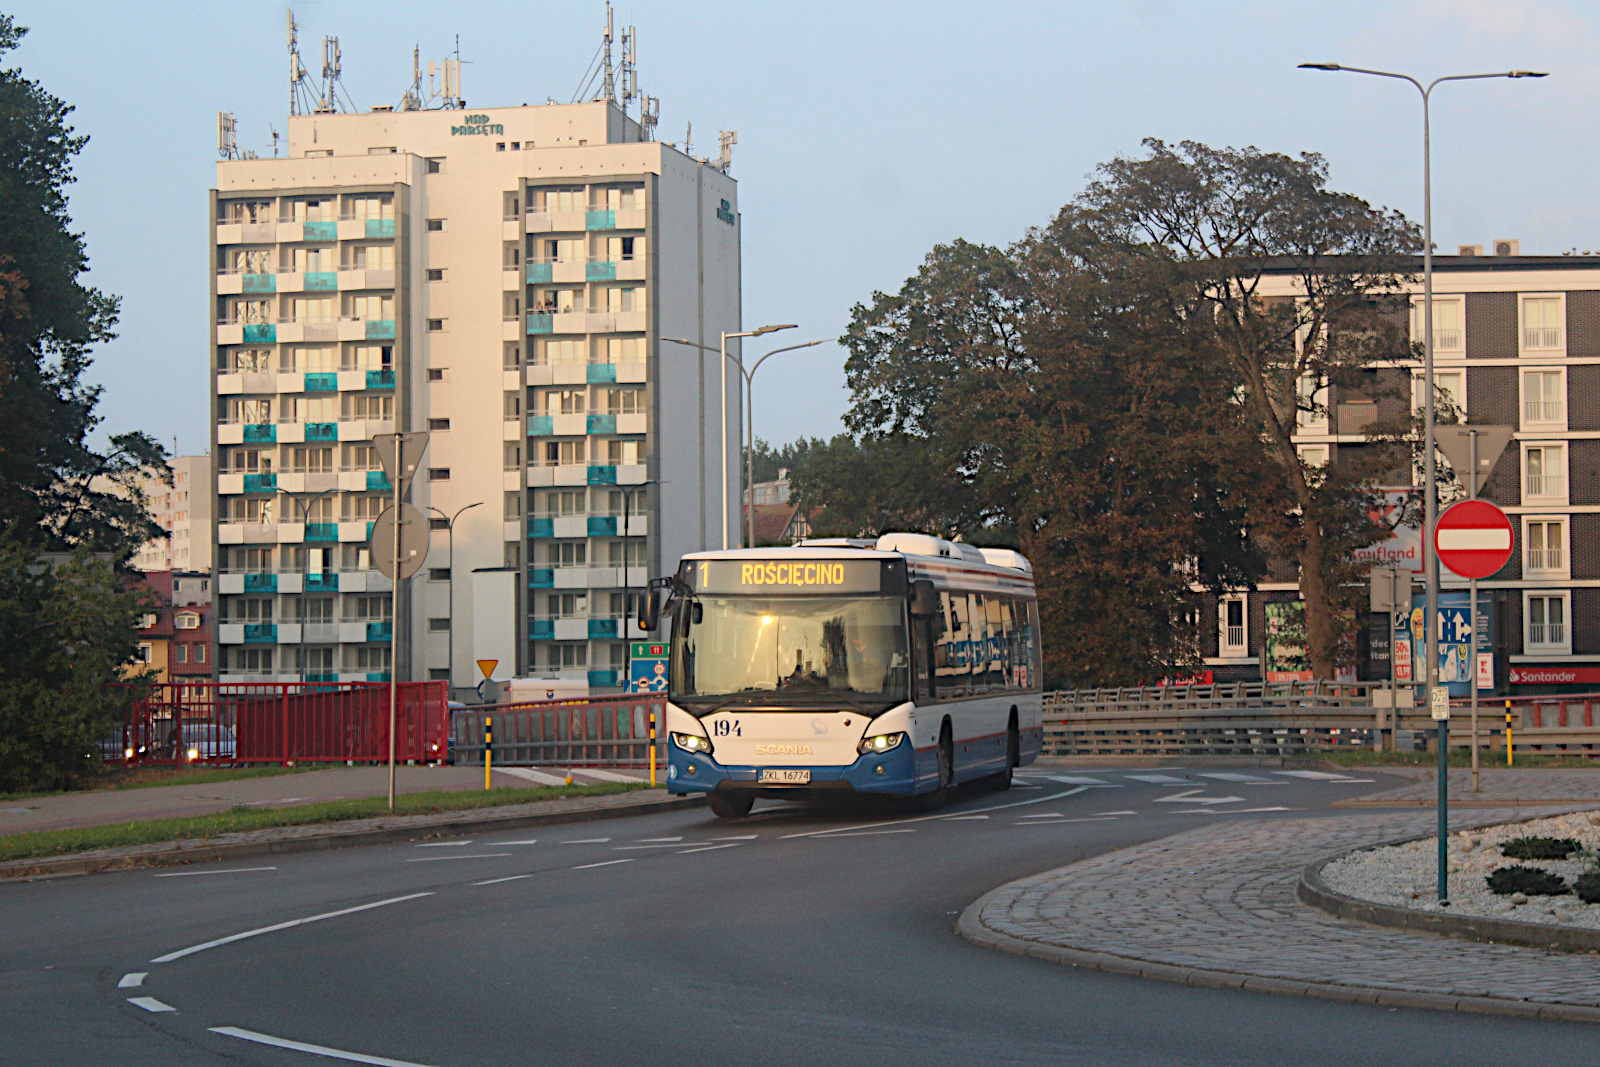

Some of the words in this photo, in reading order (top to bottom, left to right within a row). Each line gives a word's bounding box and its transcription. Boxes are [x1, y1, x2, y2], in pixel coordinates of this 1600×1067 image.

[700, 562, 709, 588] 1
[741, 562, 845, 587] ROŚCIĘCINO
[1521, 672, 1576, 682] Santander
[713, 720, 742, 737] 194
[755, 744, 813, 755] SCANIA
[763, 771, 780, 780] ZKL
[783, 771, 809, 780] 16774
